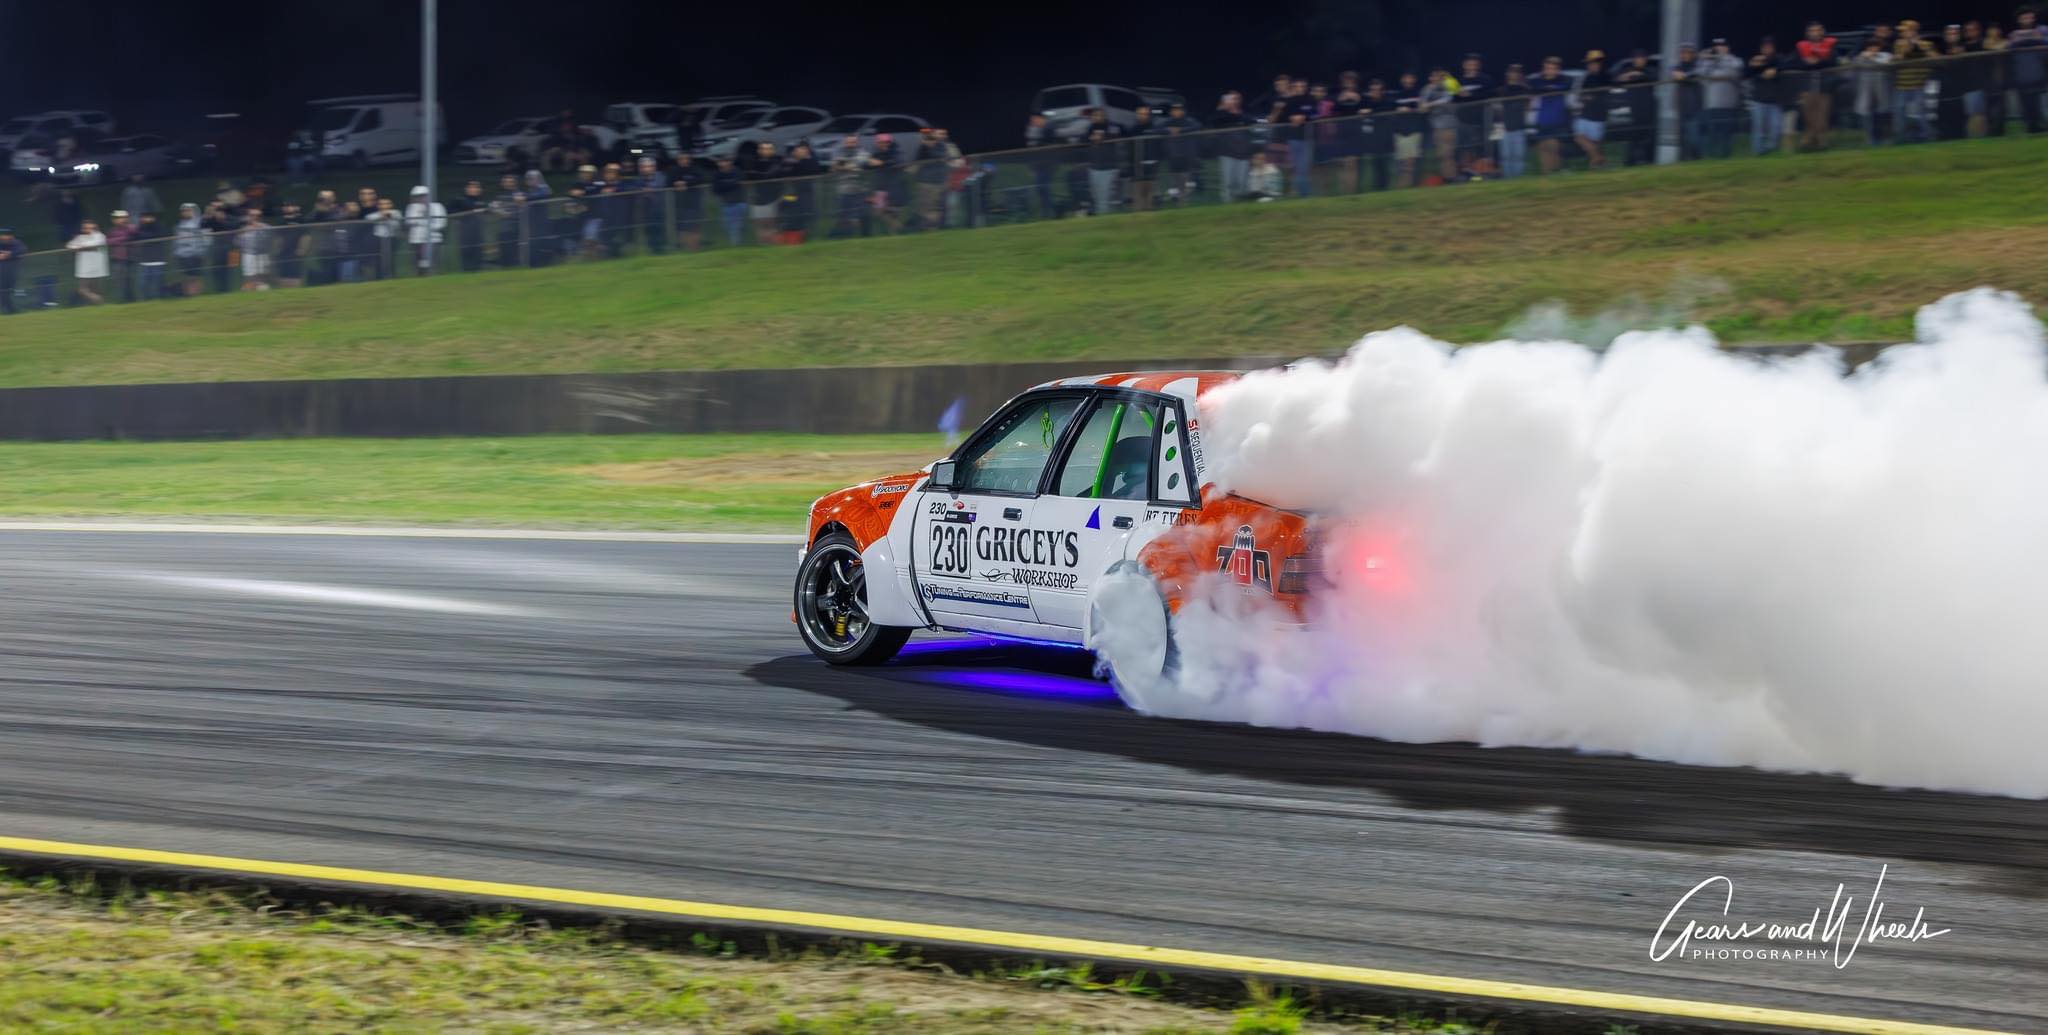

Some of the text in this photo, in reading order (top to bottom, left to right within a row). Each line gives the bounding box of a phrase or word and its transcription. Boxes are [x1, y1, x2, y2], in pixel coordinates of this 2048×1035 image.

[1191, 431, 1205, 477] SEQUENTIAL
[929, 502, 947, 515] 230
[1162, 511, 1197, 527] TYRES
[932, 525, 968, 574] 230
[976, 525, 1079, 568] GRICEY'S
[1012, 568, 1078, 589] WORKSHOP
